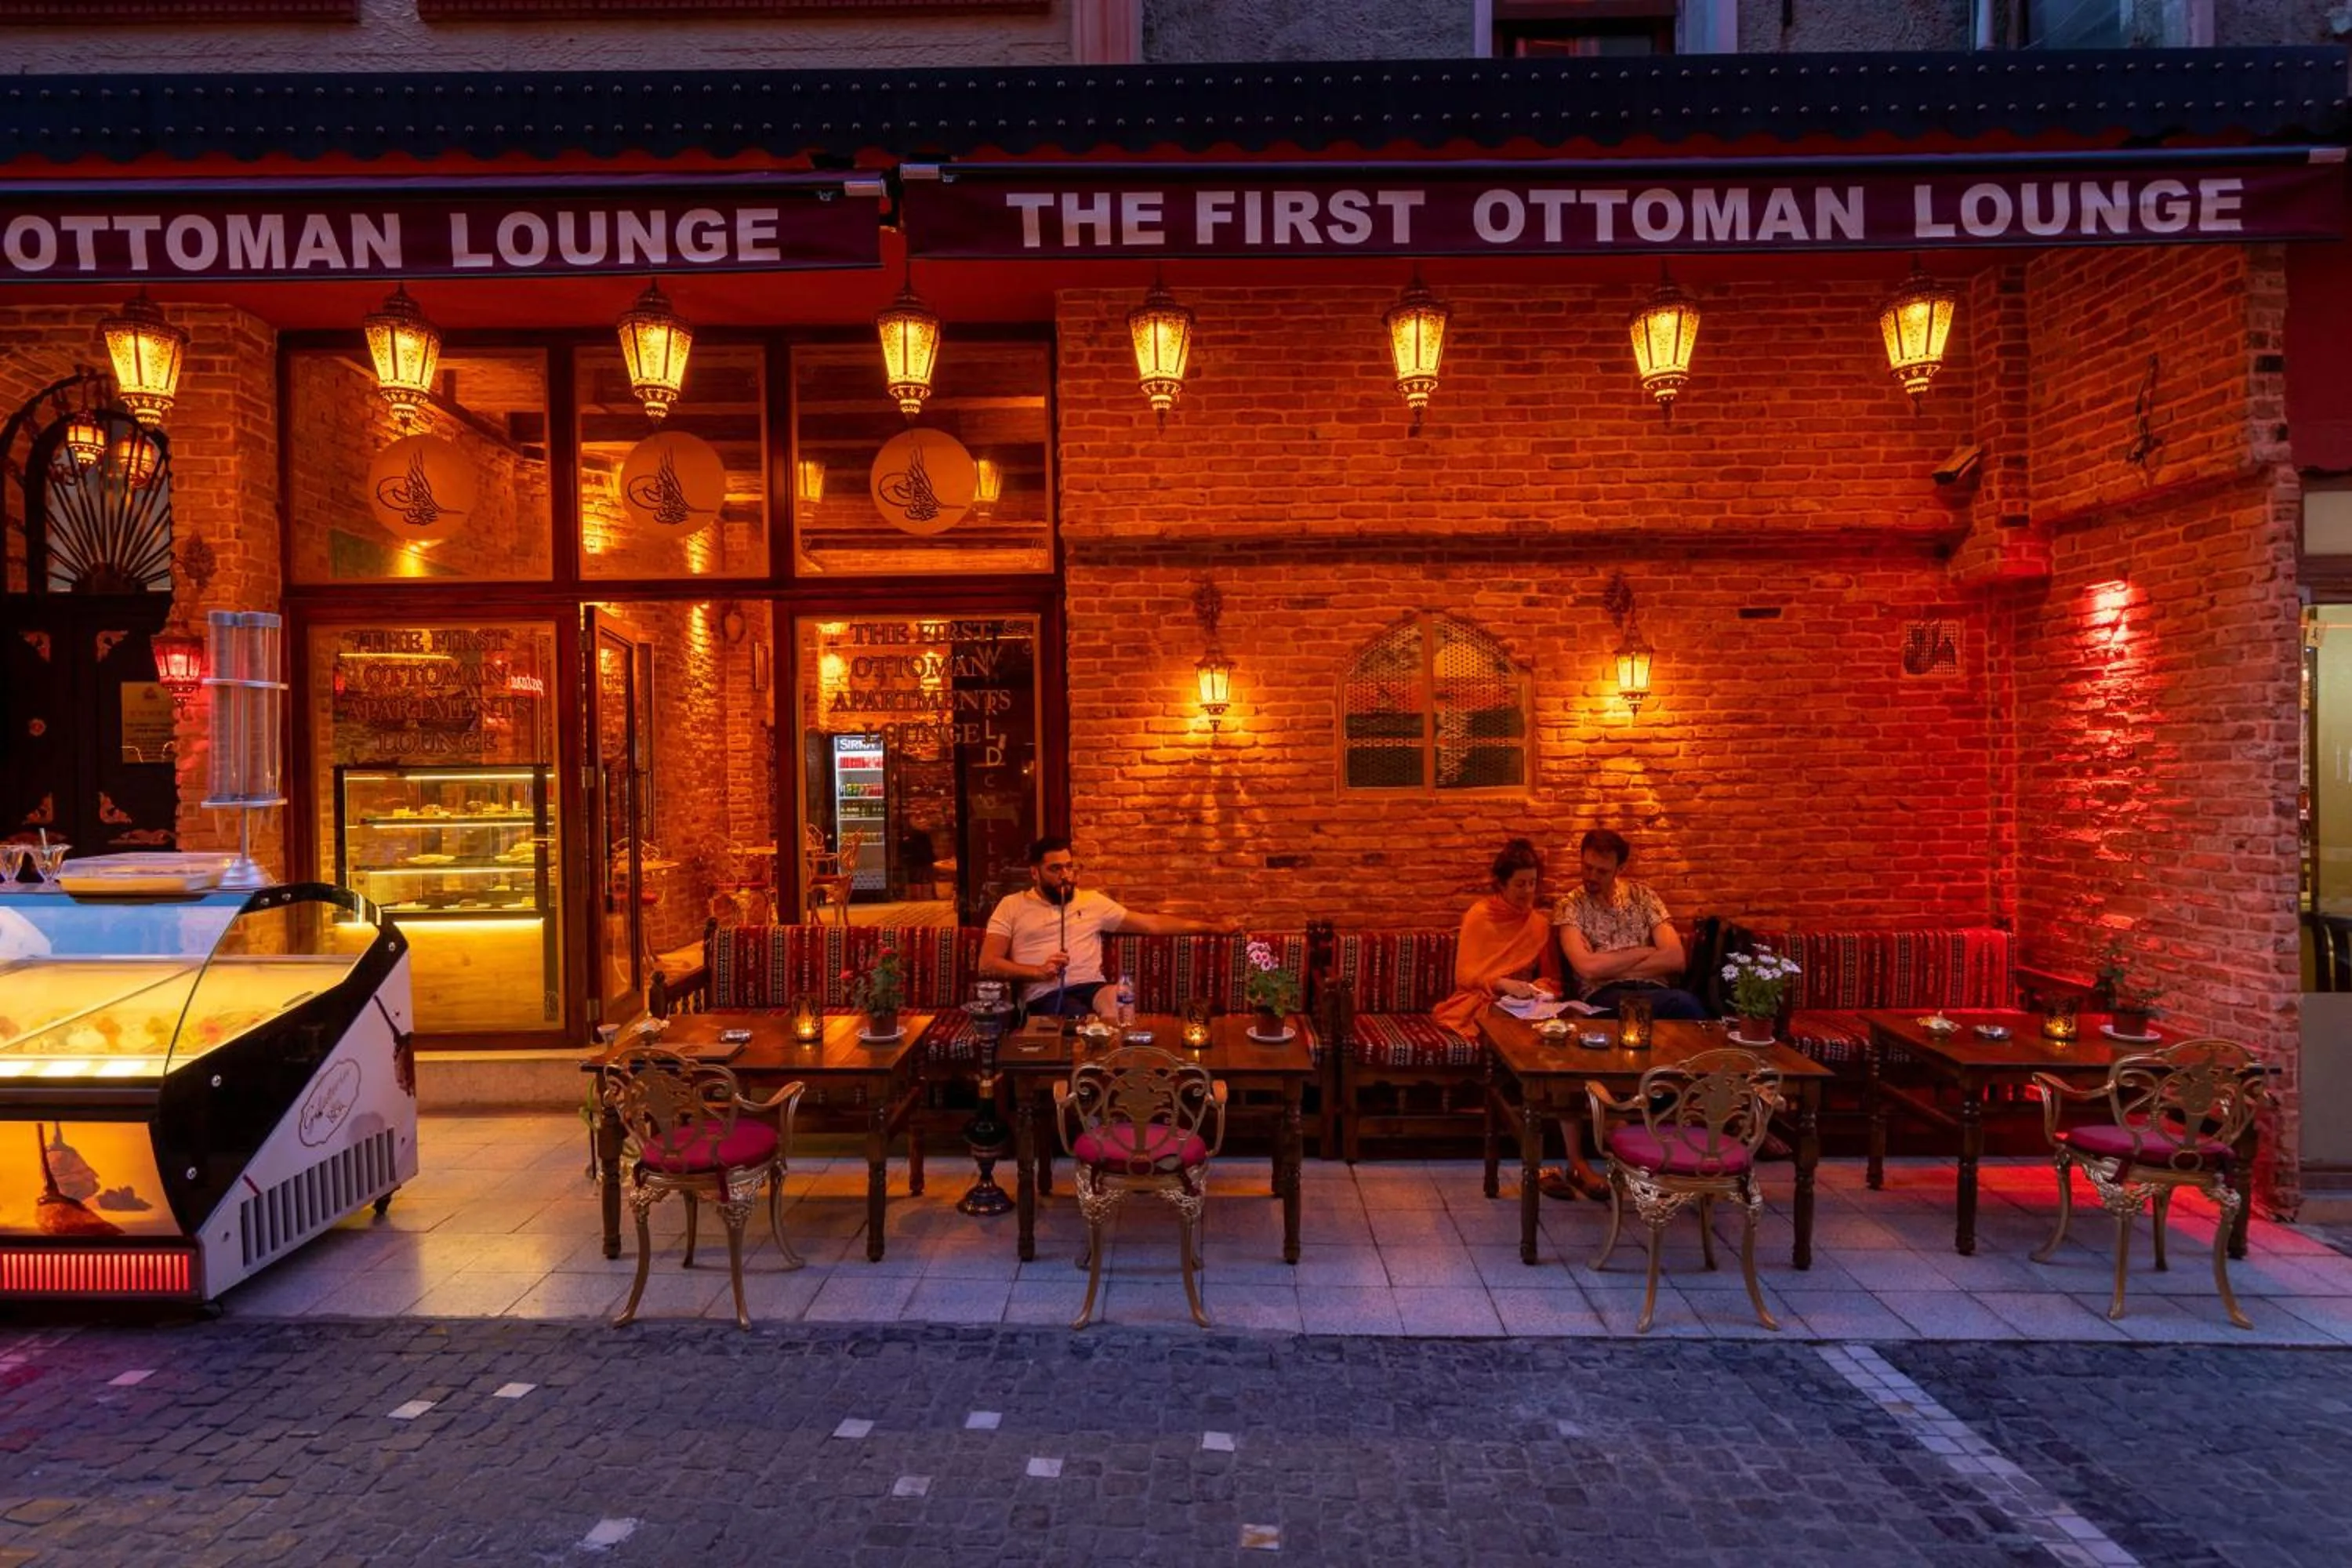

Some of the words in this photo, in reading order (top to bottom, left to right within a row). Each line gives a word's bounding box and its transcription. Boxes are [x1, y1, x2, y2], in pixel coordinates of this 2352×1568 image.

[1005, 192, 1165, 249] THE
[1196, 191, 1425, 245] FIRST
[1472, 187, 1864, 244] OTTOMAN
[1914, 178, 2244, 239] LOUNGE
[3, 214, 403, 271] OTTOMAN
[452, 209, 781, 268] LOUNGE
[363, 630, 423, 652] THE
[431, 630, 508, 652] FIRST
[850, 622, 909, 644] THE
[916, 622, 992, 644] FIRST
[364, 663, 508, 686] OTTOMAN
[851, 655, 991, 677] OTTOMAN
[347, 696, 528, 718] APARTMENTS
[829, 689, 1012, 712] APARTMENTS
[375, 731, 498, 753] LOUNGE
[862, 722, 980, 744] LOUNGE
